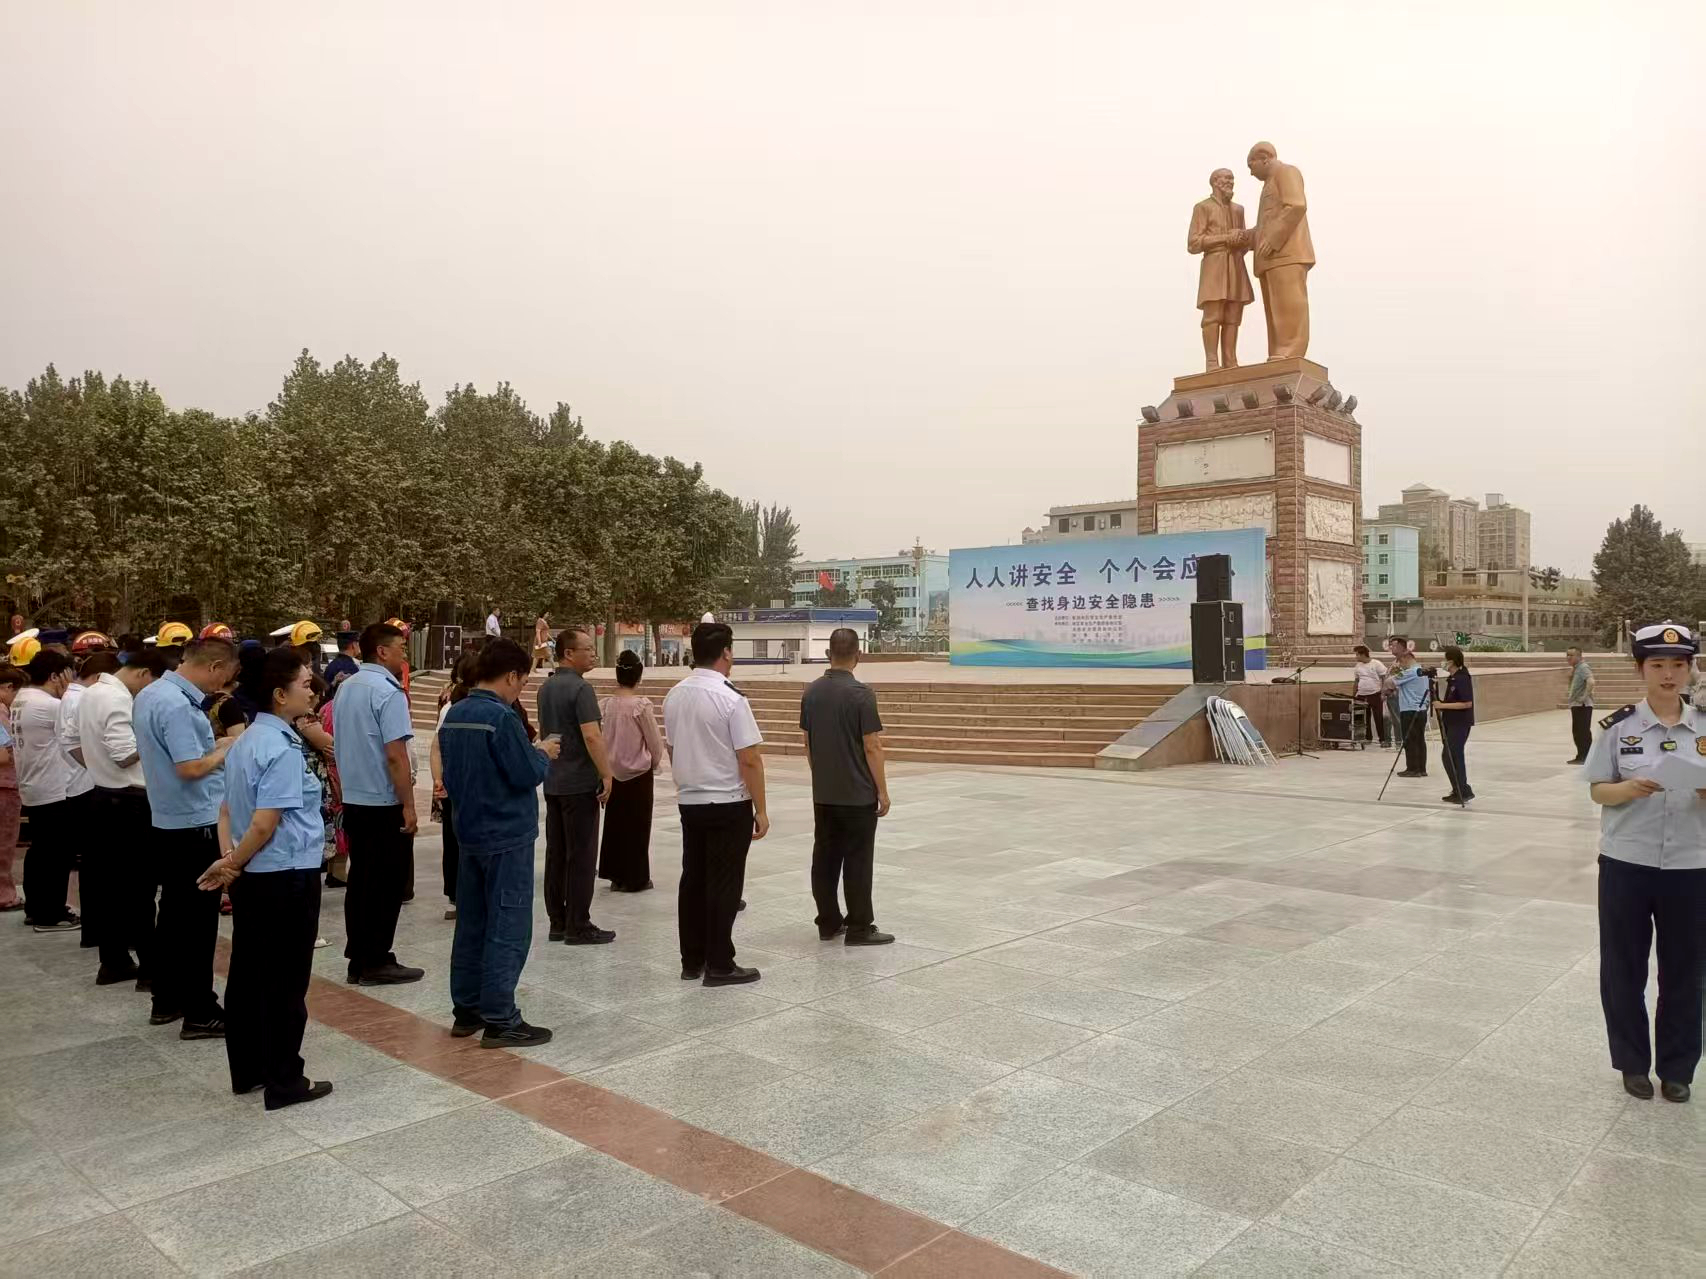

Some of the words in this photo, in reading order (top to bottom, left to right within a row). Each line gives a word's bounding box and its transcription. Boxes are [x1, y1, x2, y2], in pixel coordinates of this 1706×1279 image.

[965, 561, 1078, 589] 人人讲安全
[1099, 553, 1236, 584] 个个会应
[1025, 592, 1156, 612] 查找身边安全隐患
